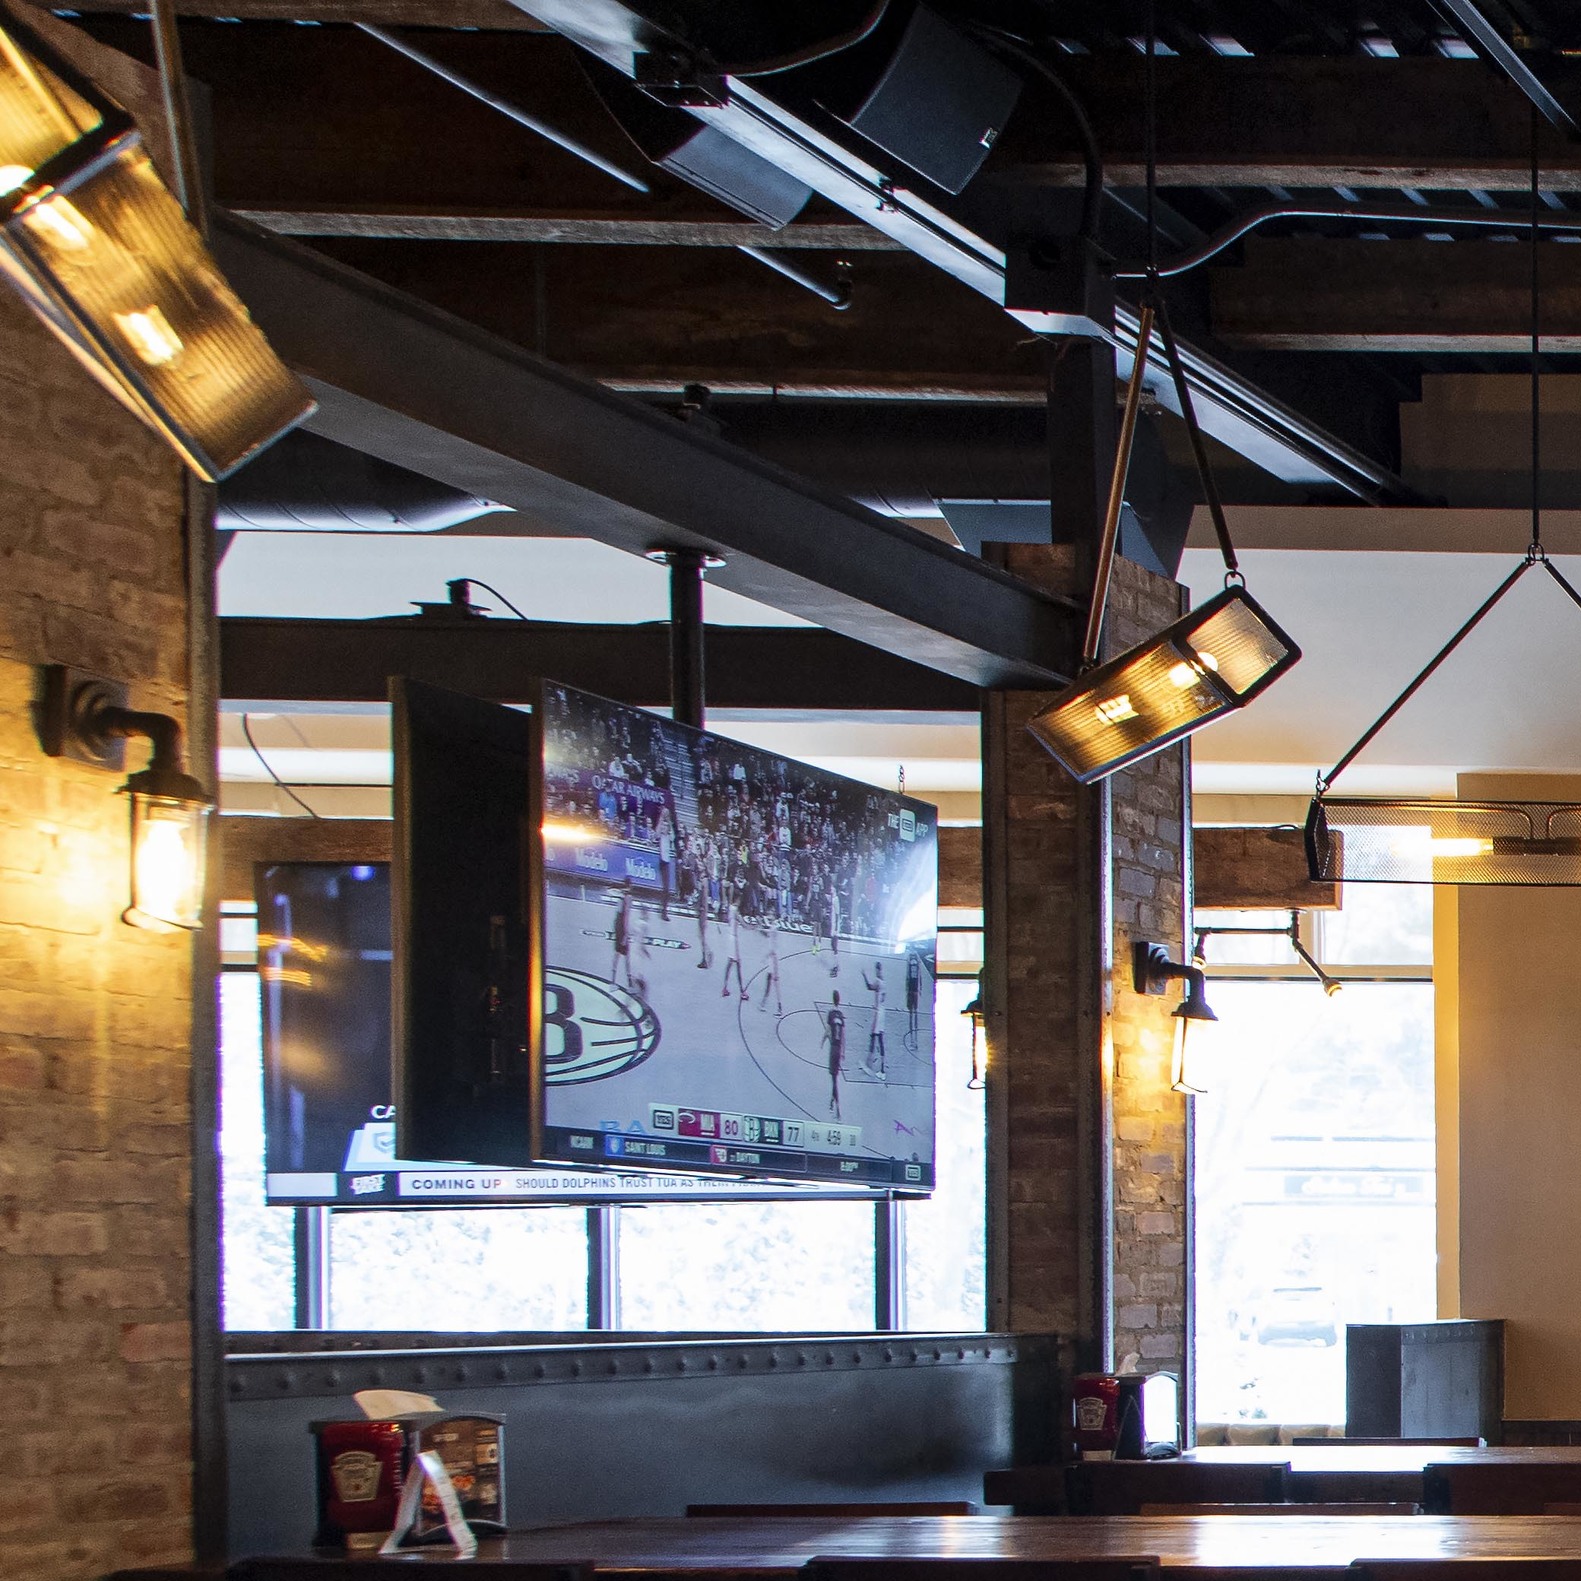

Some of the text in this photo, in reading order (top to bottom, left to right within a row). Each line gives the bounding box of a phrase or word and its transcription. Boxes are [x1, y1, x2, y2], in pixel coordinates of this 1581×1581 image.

[725, 1119, 739, 1136] 80
[787, 1126, 800, 1142] 77
[411, 1179, 476, 1190] COMING
[481, 1179, 502, 1190] UP
[515, 1177, 560, 1189] SHOULD
[562, 1177, 616, 1189] DOLPHINS
